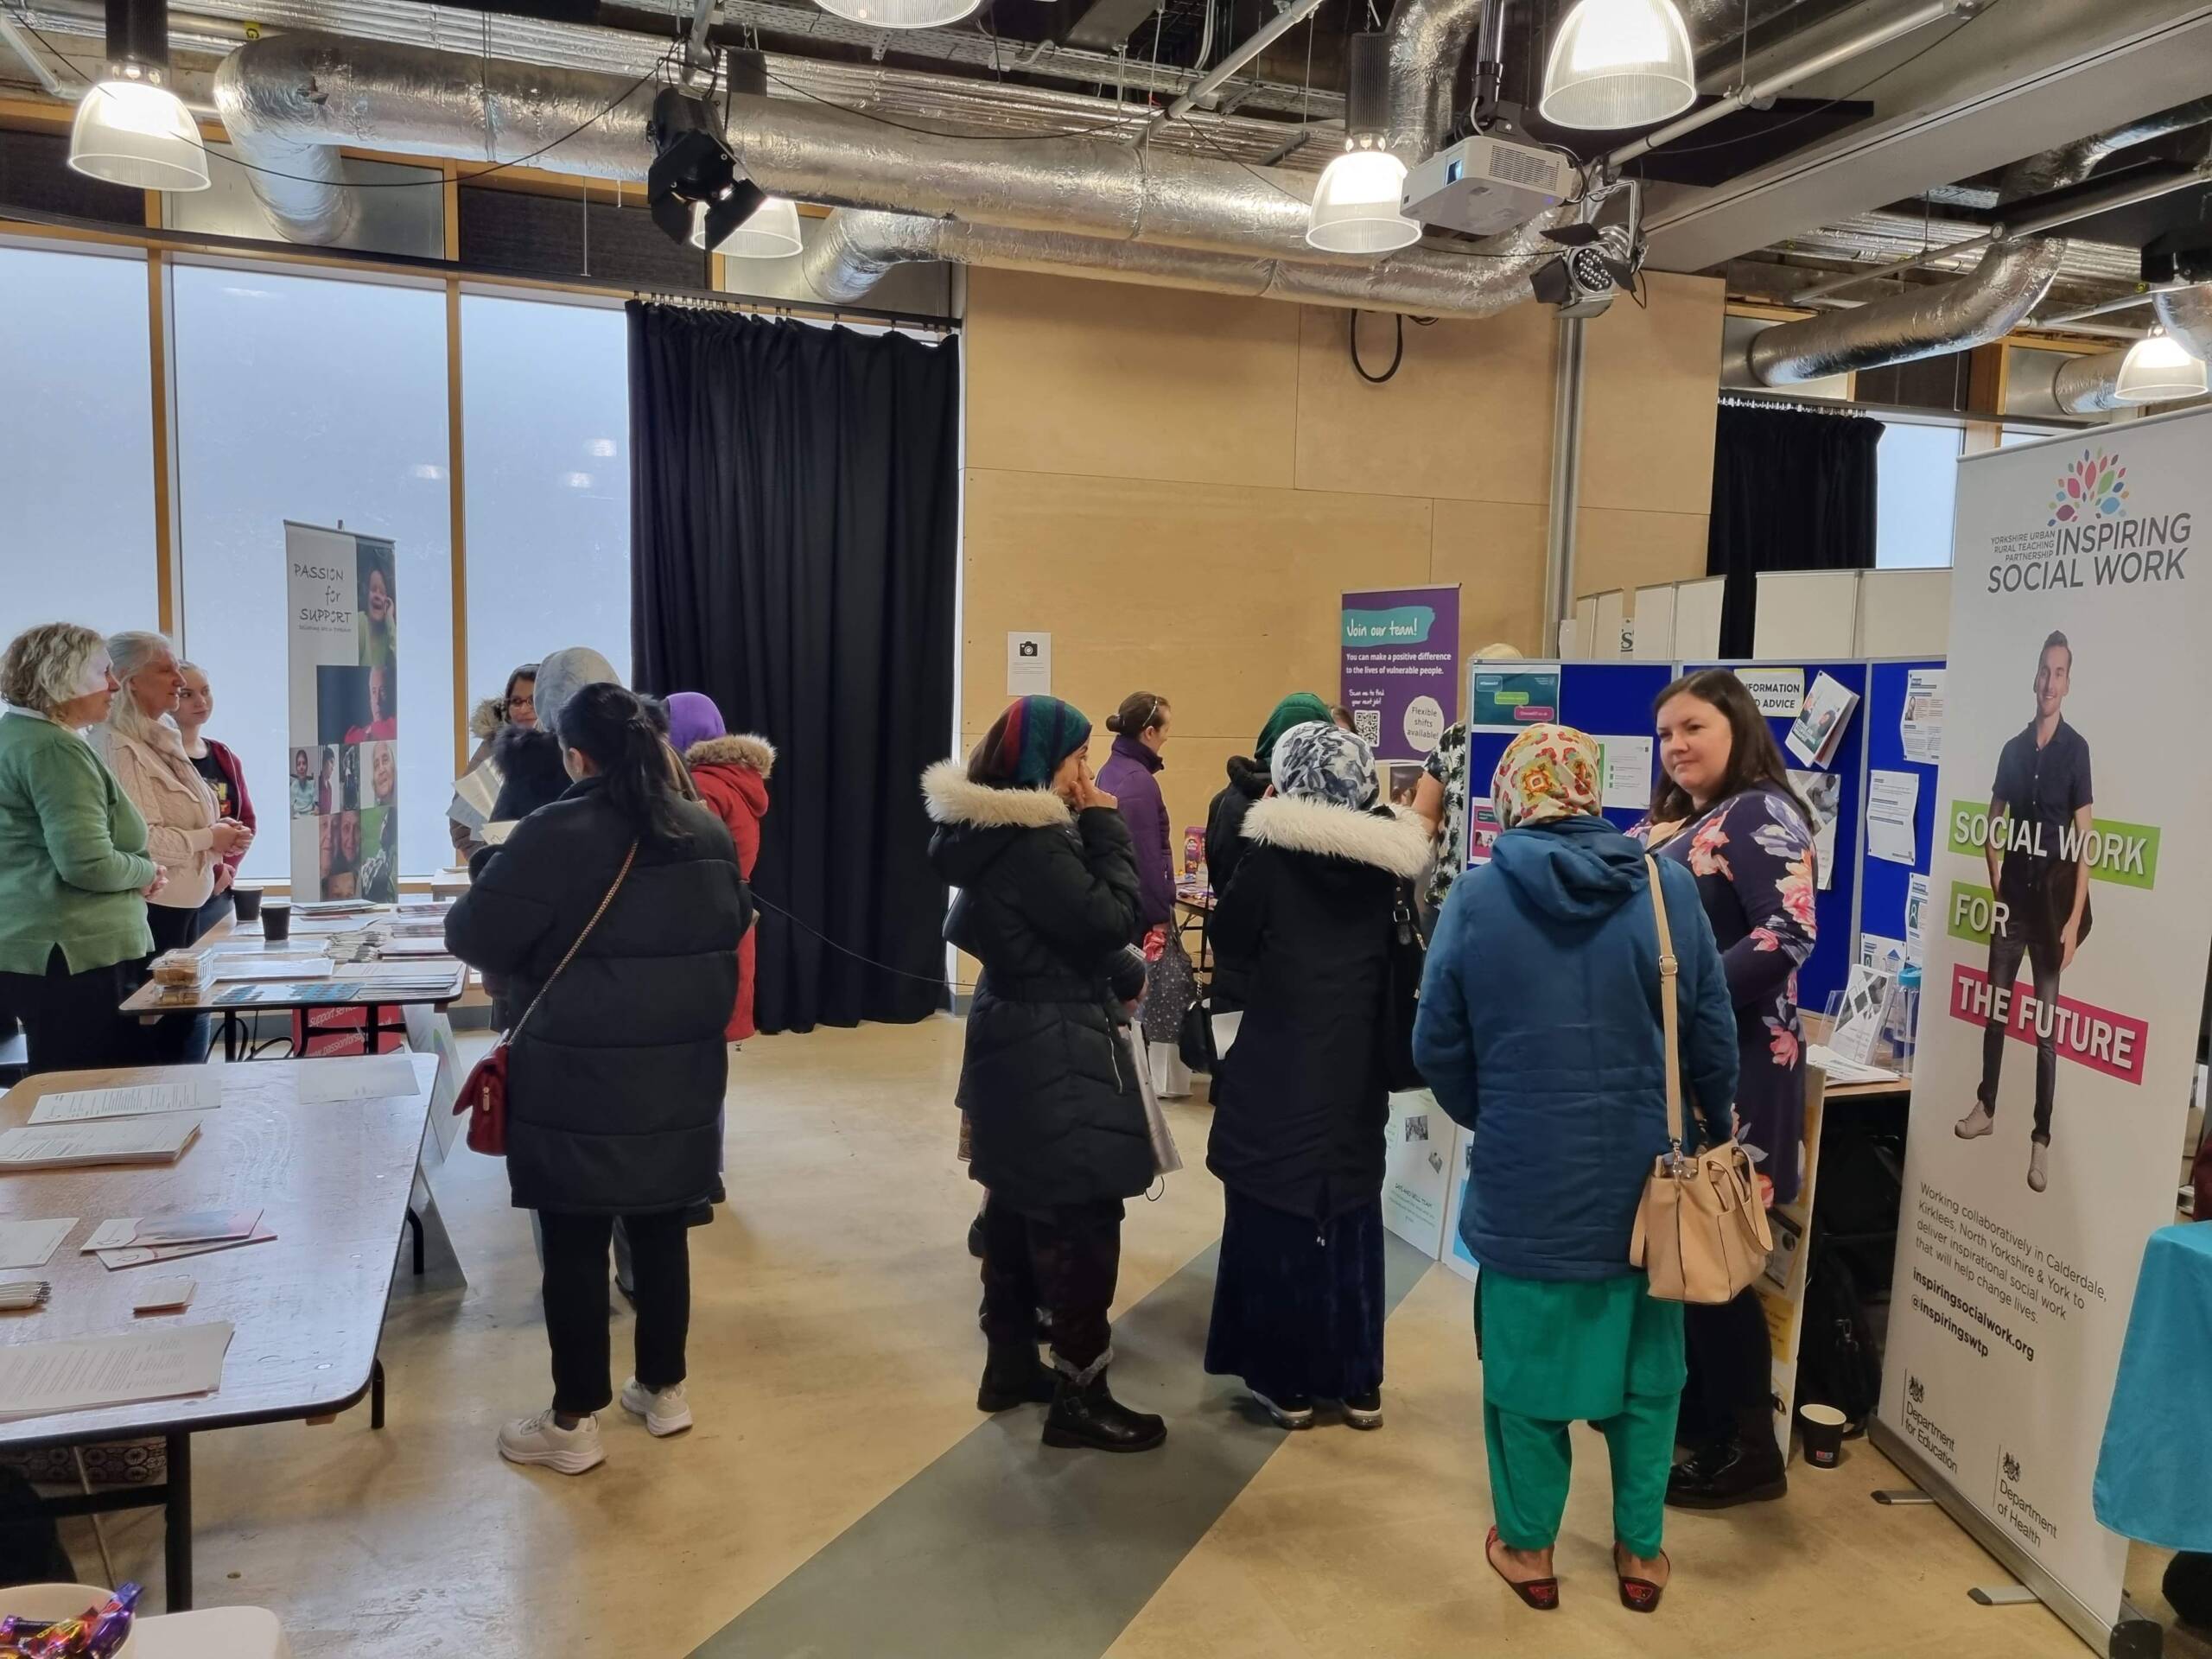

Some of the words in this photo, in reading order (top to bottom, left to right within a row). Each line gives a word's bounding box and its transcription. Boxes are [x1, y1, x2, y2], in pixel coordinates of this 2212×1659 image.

[1991, 533, 2028, 544] YORKSHIRE
[2031, 530, 2056, 540] URBAN
[1994, 544, 2016, 554] RURAL
[2018, 540, 2054, 551] TEACHING
[2005, 550, 2053, 561] PARTNERSHIP
[2056, 512, 2191, 556] INSPIRING
[294, 563, 344, 581] PASSION
[1987, 558, 2083, 594] SOCIAL
[2094, 547, 2189, 586] WORK
[299, 608, 352, 623] SUPPORT
[325, 585, 340, 605] for
[1346, 618, 1367, 637] Join
[1370, 626, 1387, 637] our
[1389, 617, 1417, 636] team!
[1370, 652, 1387, 661] make
[1392, 652, 1417, 662] positive
[1417, 652, 1452, 661] difference
[1379, 665, 1386, 674] of
[1386, 665, 1419, 674] vulnerable
[1420, 666, 1445, 676] people.
[1745, 683, 1801, 692] FORMATION
[1763, 699, 1796, 709] ADVICE
[1411, 707, 1437, 717] Flexible
[1414, 718, 1433, 728] shifts
[1954, 811, 2048, 857] SOCIAL
[2059, 825, 2148, 875] WORK
[1954, 893, 2010, 938] FOR
[1958, 976, 2012, 1024] THE
[2018, 995, 2136, 1070] FUTURE
[1918, 1199, 1956, 1232] Kirklees,
[1960, 1223, 1987, 1248] North
[1990, 1238, 2034, 1277] Yorkshire
[2037, 1269, 2044, 1284] &
[2048, 1274, 2070, 1300] York
[2074, 1293, 2085, 1309] to
[1921, 1181, 1960, 1214] Working
[1961, 1207, 2031, 1255] collaboratively
[2035, 1245, 2044, 1262] in
[2046, 1254, 2107, 1302] Calderdale,
[1916, 1219, 1948, 1244] deliver
[1950, 1236, 2008, 1281] inspirational
[2010, 1276, 2038, 1301] social
[2041, 1295, 2067, 1320] work
[1916, 1236, 1934, 1256] that
[1936, 1250, 1952, 1267] will
[1954, 1258, 1974, 1281] help
[1977, 1274, 2012, 1306] change
[2014, 1297, 2038, 1324] lives.
[1910, 1294, 1988, 1357] @inspiringswtp
[1913, 1267, 2035, 1362] inspiringsocialwork.org
[1905, 1418, 1916, 1436] for
[1917, 1430, 1957, 1474] Education
[1906, 1401, 1955, 1452] Department
[1998, 1503, 2007, 1517] of
[2010, 1510, 2041, 1548] Health
[2000, 1479, 2057, 1539] Department
